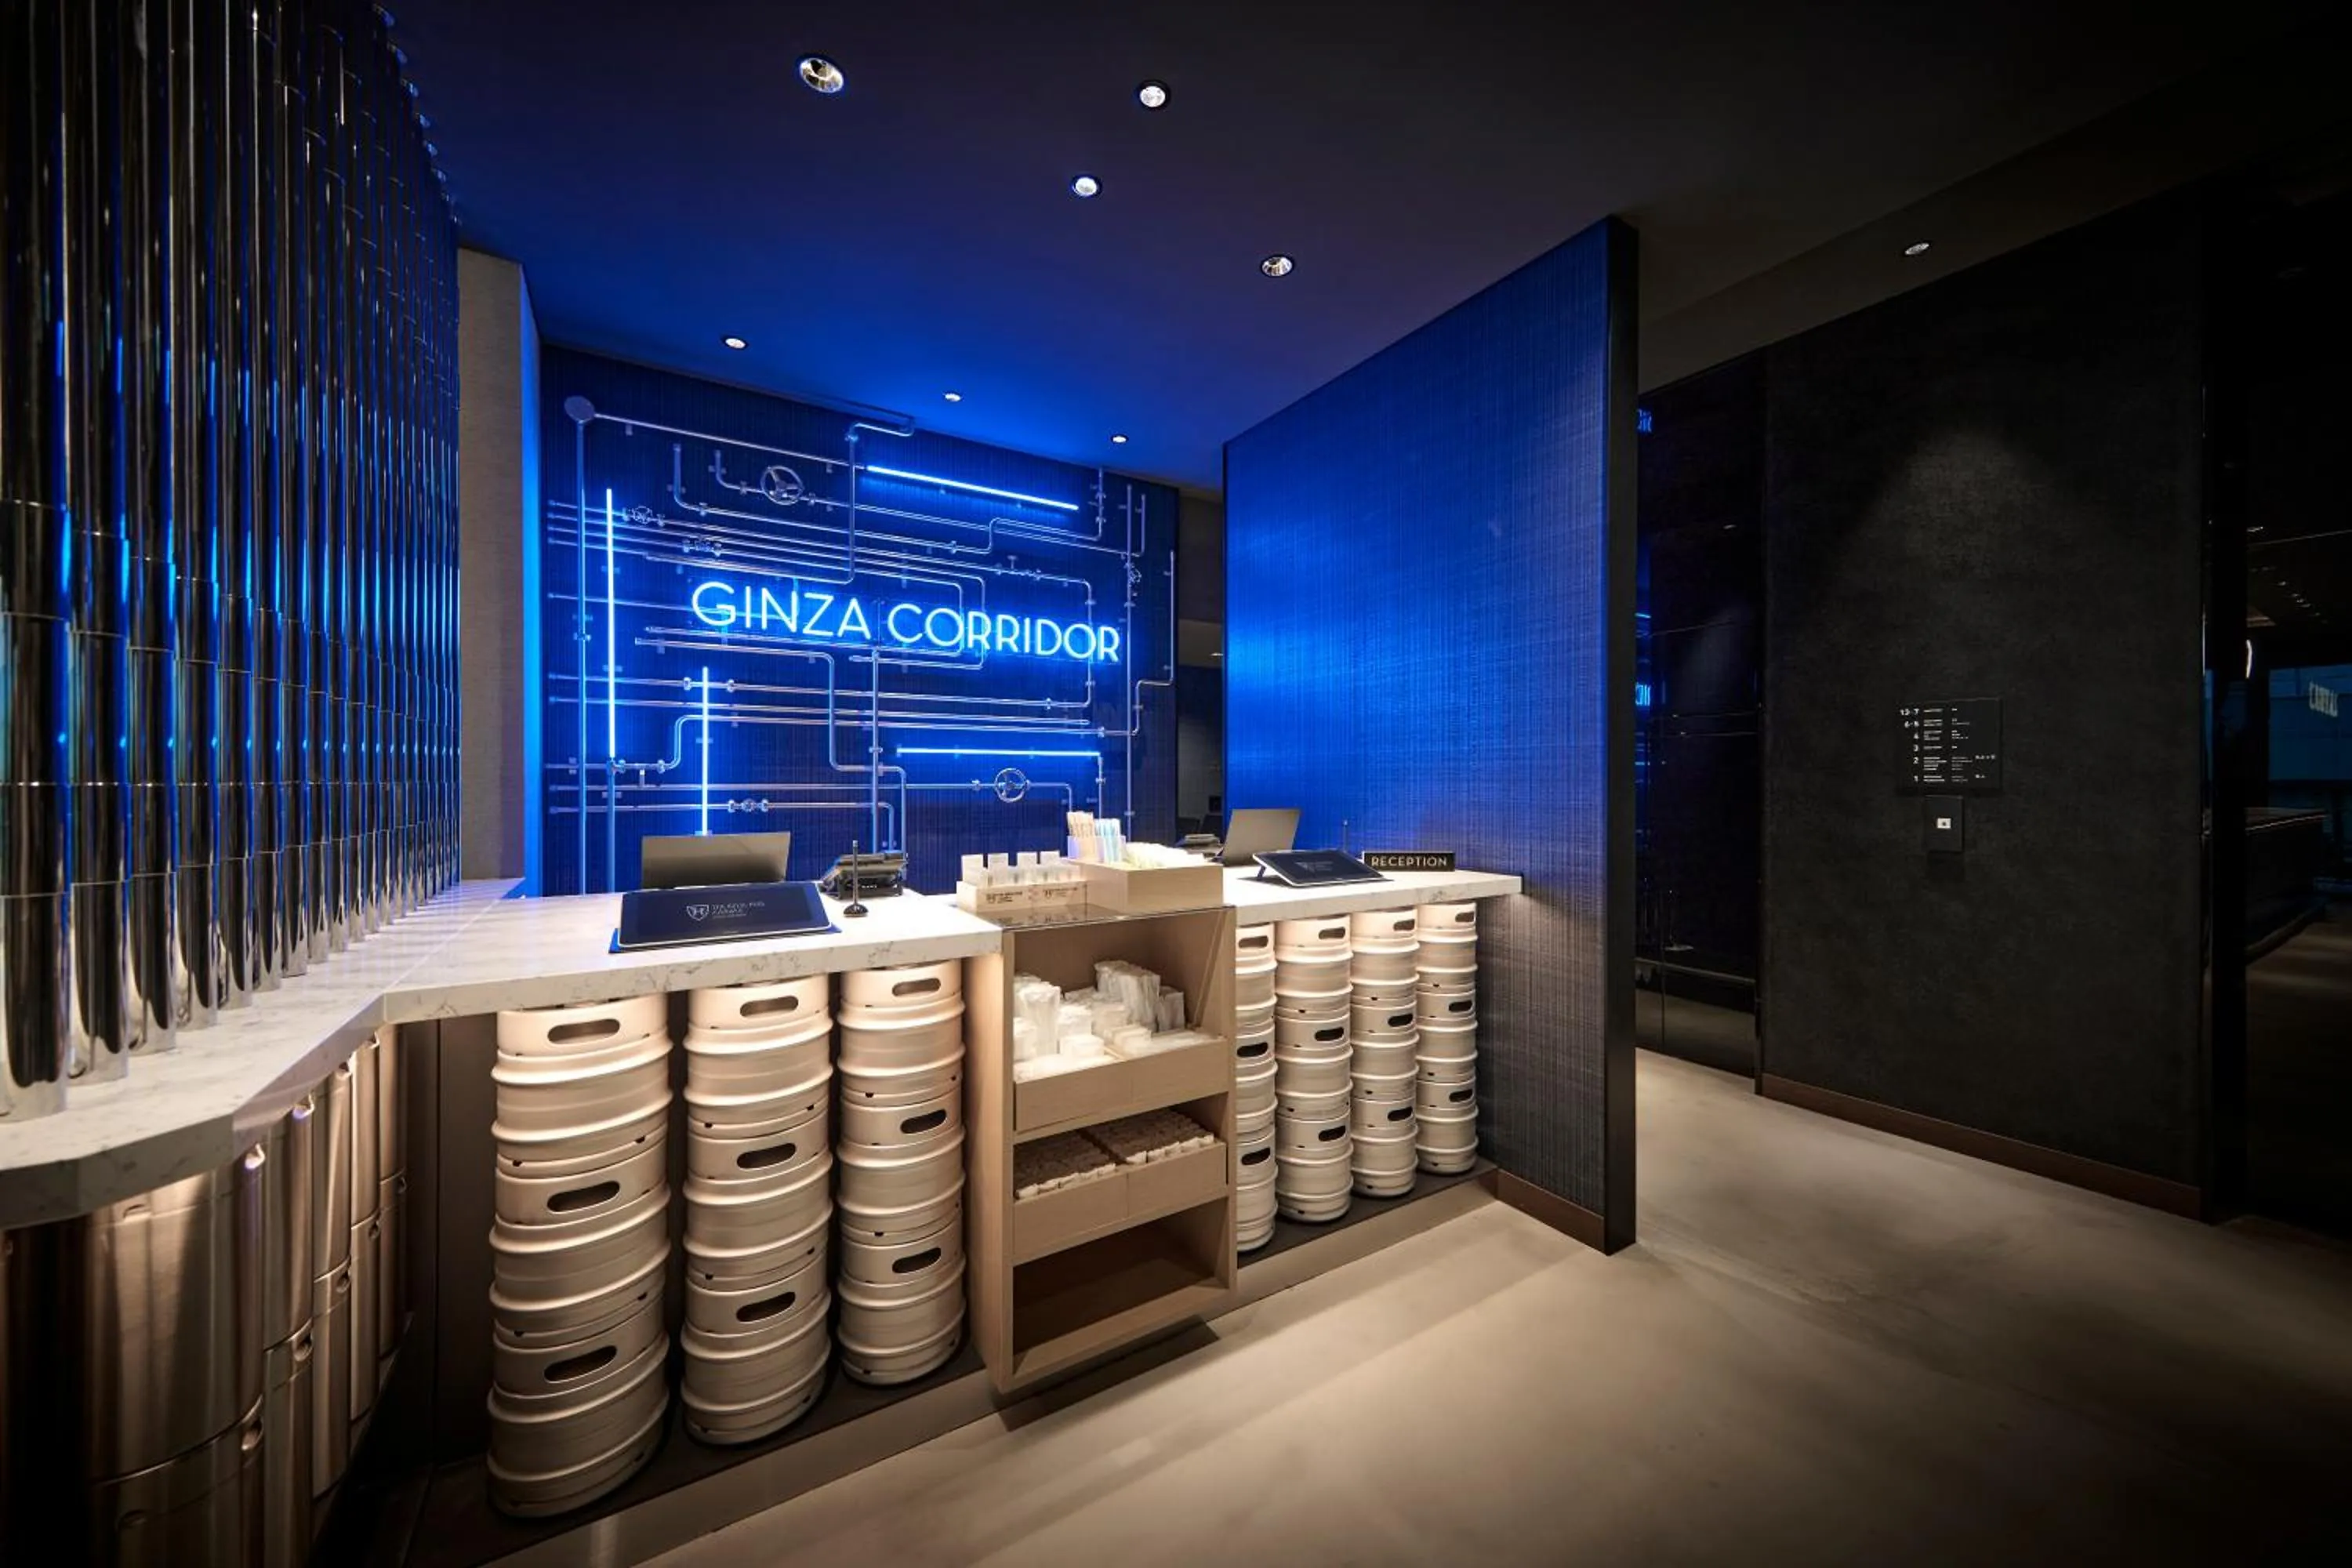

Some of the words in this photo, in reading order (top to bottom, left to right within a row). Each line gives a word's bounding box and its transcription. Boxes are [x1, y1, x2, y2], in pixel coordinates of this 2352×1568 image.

[691, 581, 871, 640] GINZA
[887, 603, 1120, 662] CORRIDOR
[1371, 856, 1446, 866] RECEPTION
